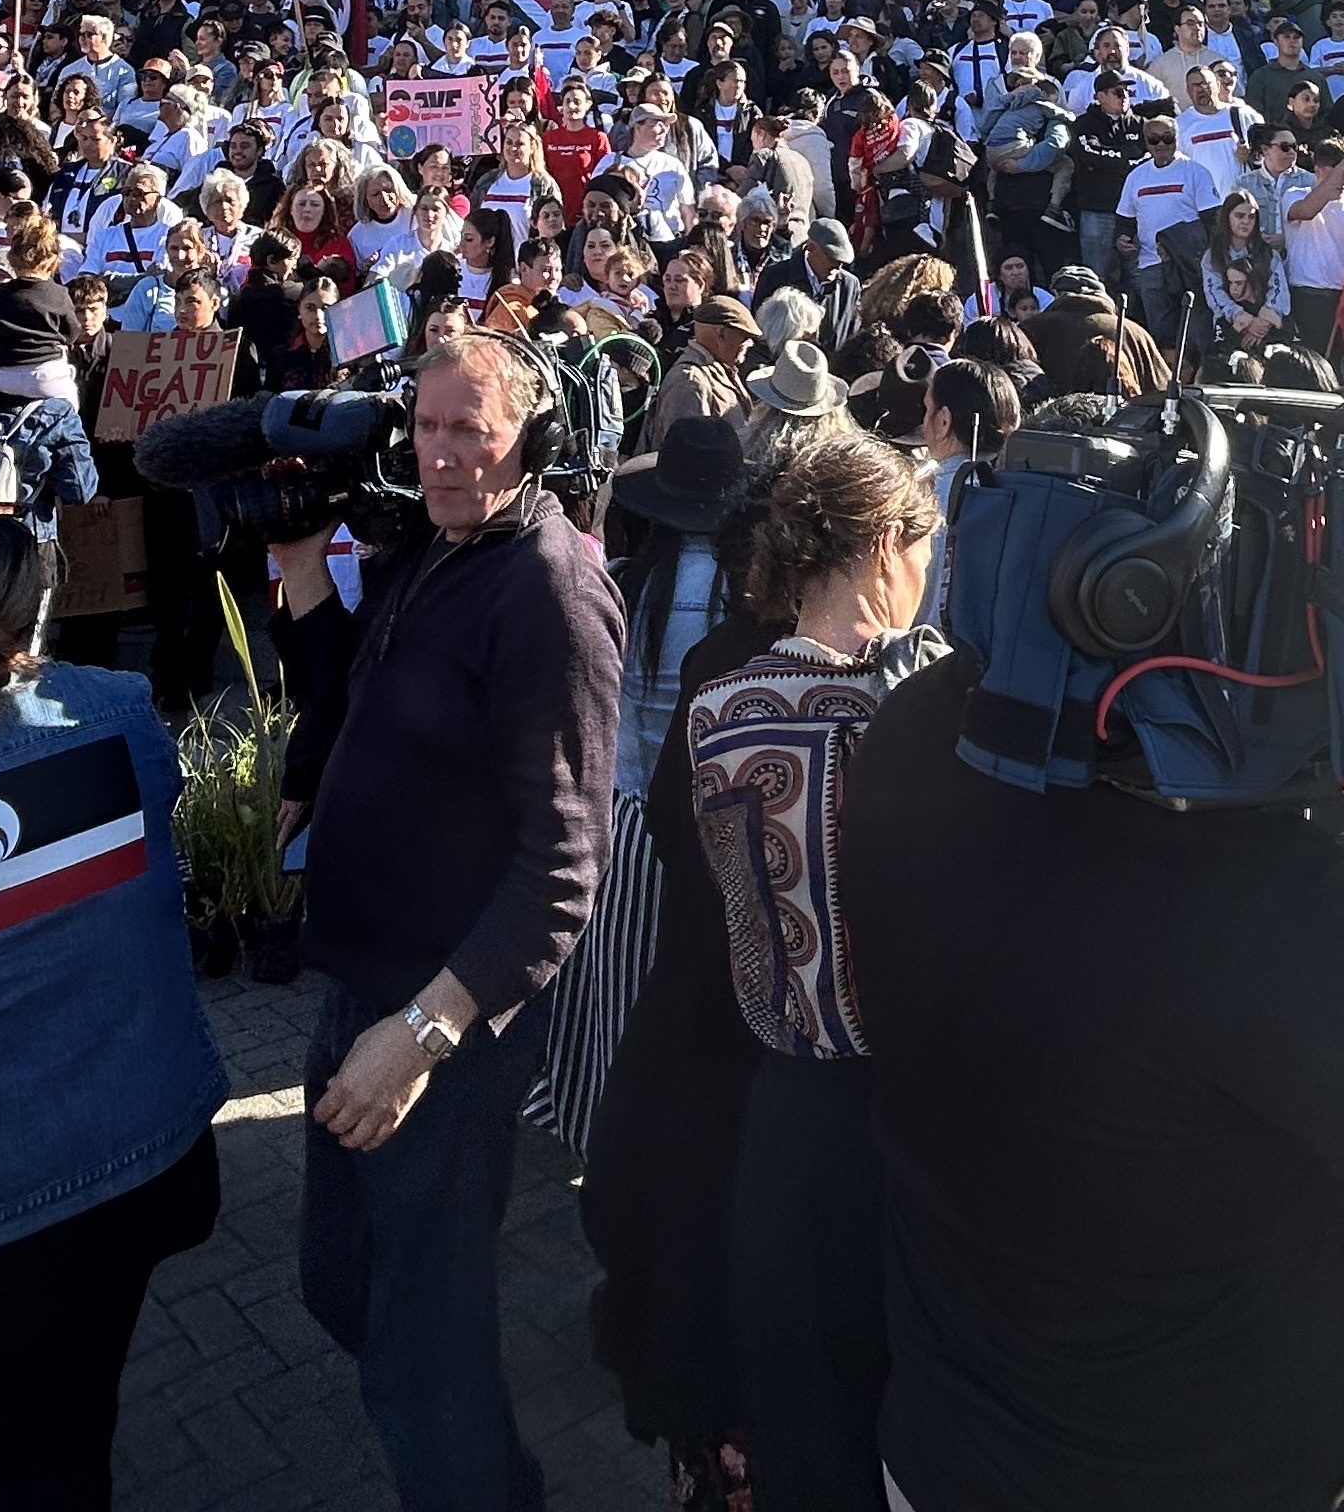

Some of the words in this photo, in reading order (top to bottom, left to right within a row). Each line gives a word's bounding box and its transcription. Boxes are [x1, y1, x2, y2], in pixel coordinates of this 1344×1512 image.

[388, 89, 463, 122] SAVE
[145, 332, 166, 364] E
[102, 363, 223, 408] NGATI
